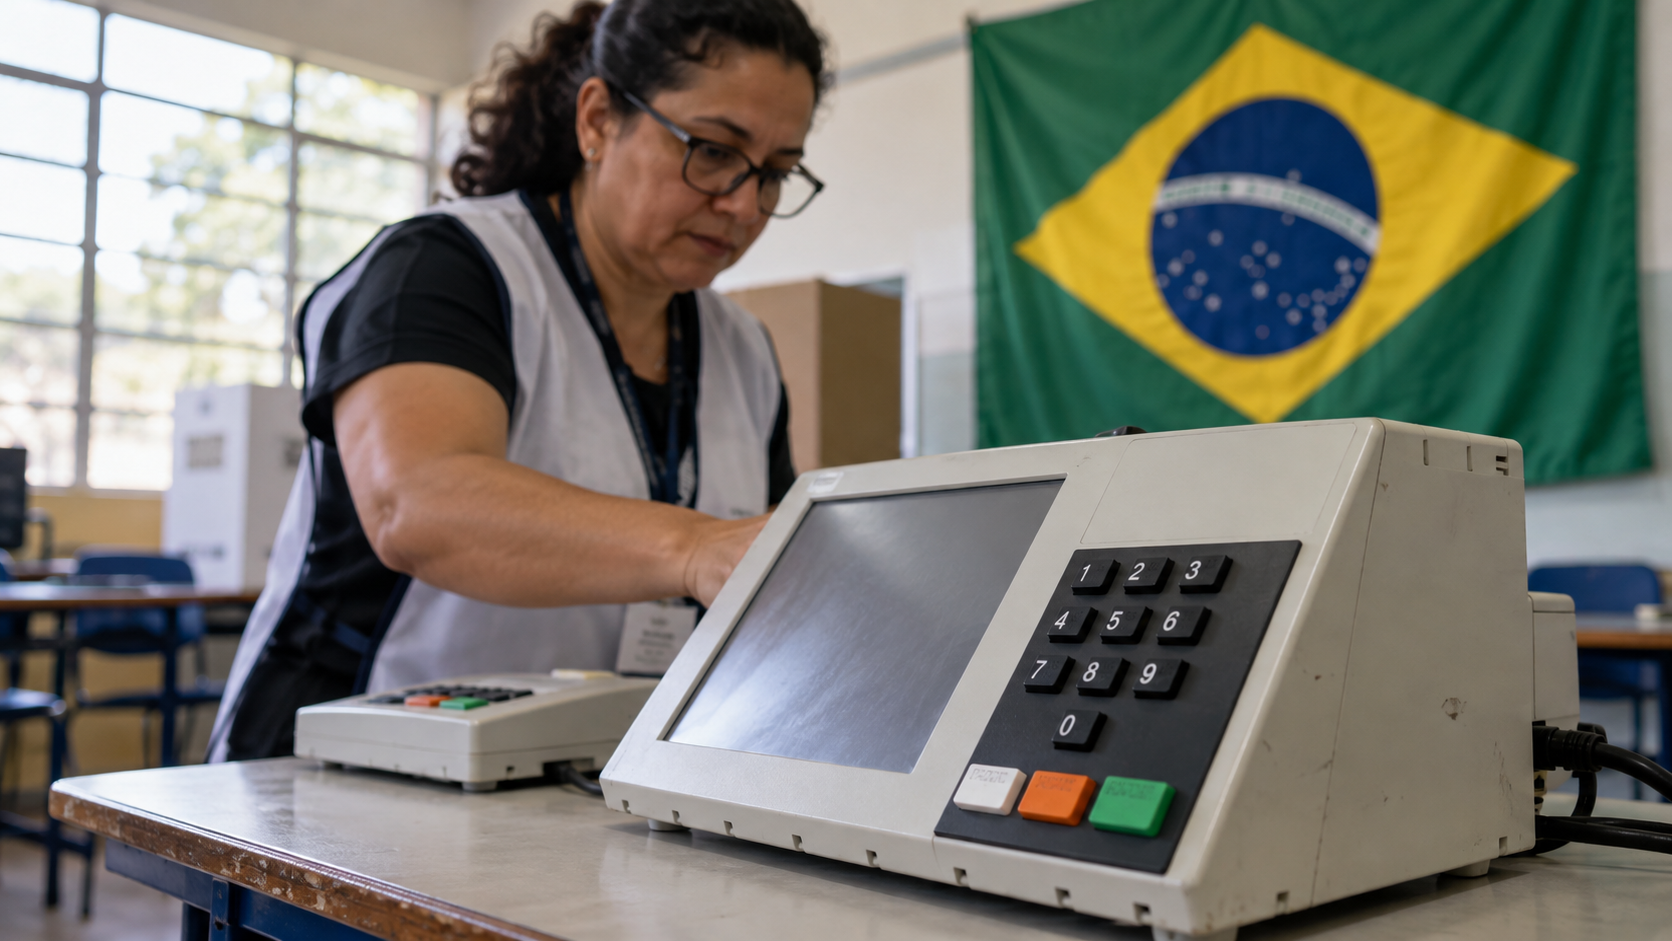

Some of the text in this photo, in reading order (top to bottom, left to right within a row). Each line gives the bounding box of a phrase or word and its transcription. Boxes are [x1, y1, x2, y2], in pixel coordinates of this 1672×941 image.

[1081, 561, 1201, 581] 1 2 3
[1054, 611, 1180, 631] 4 5 6
[1031, 660, 1157, 684] 7 8 9
[1059, 715, 1075, 736] 0
